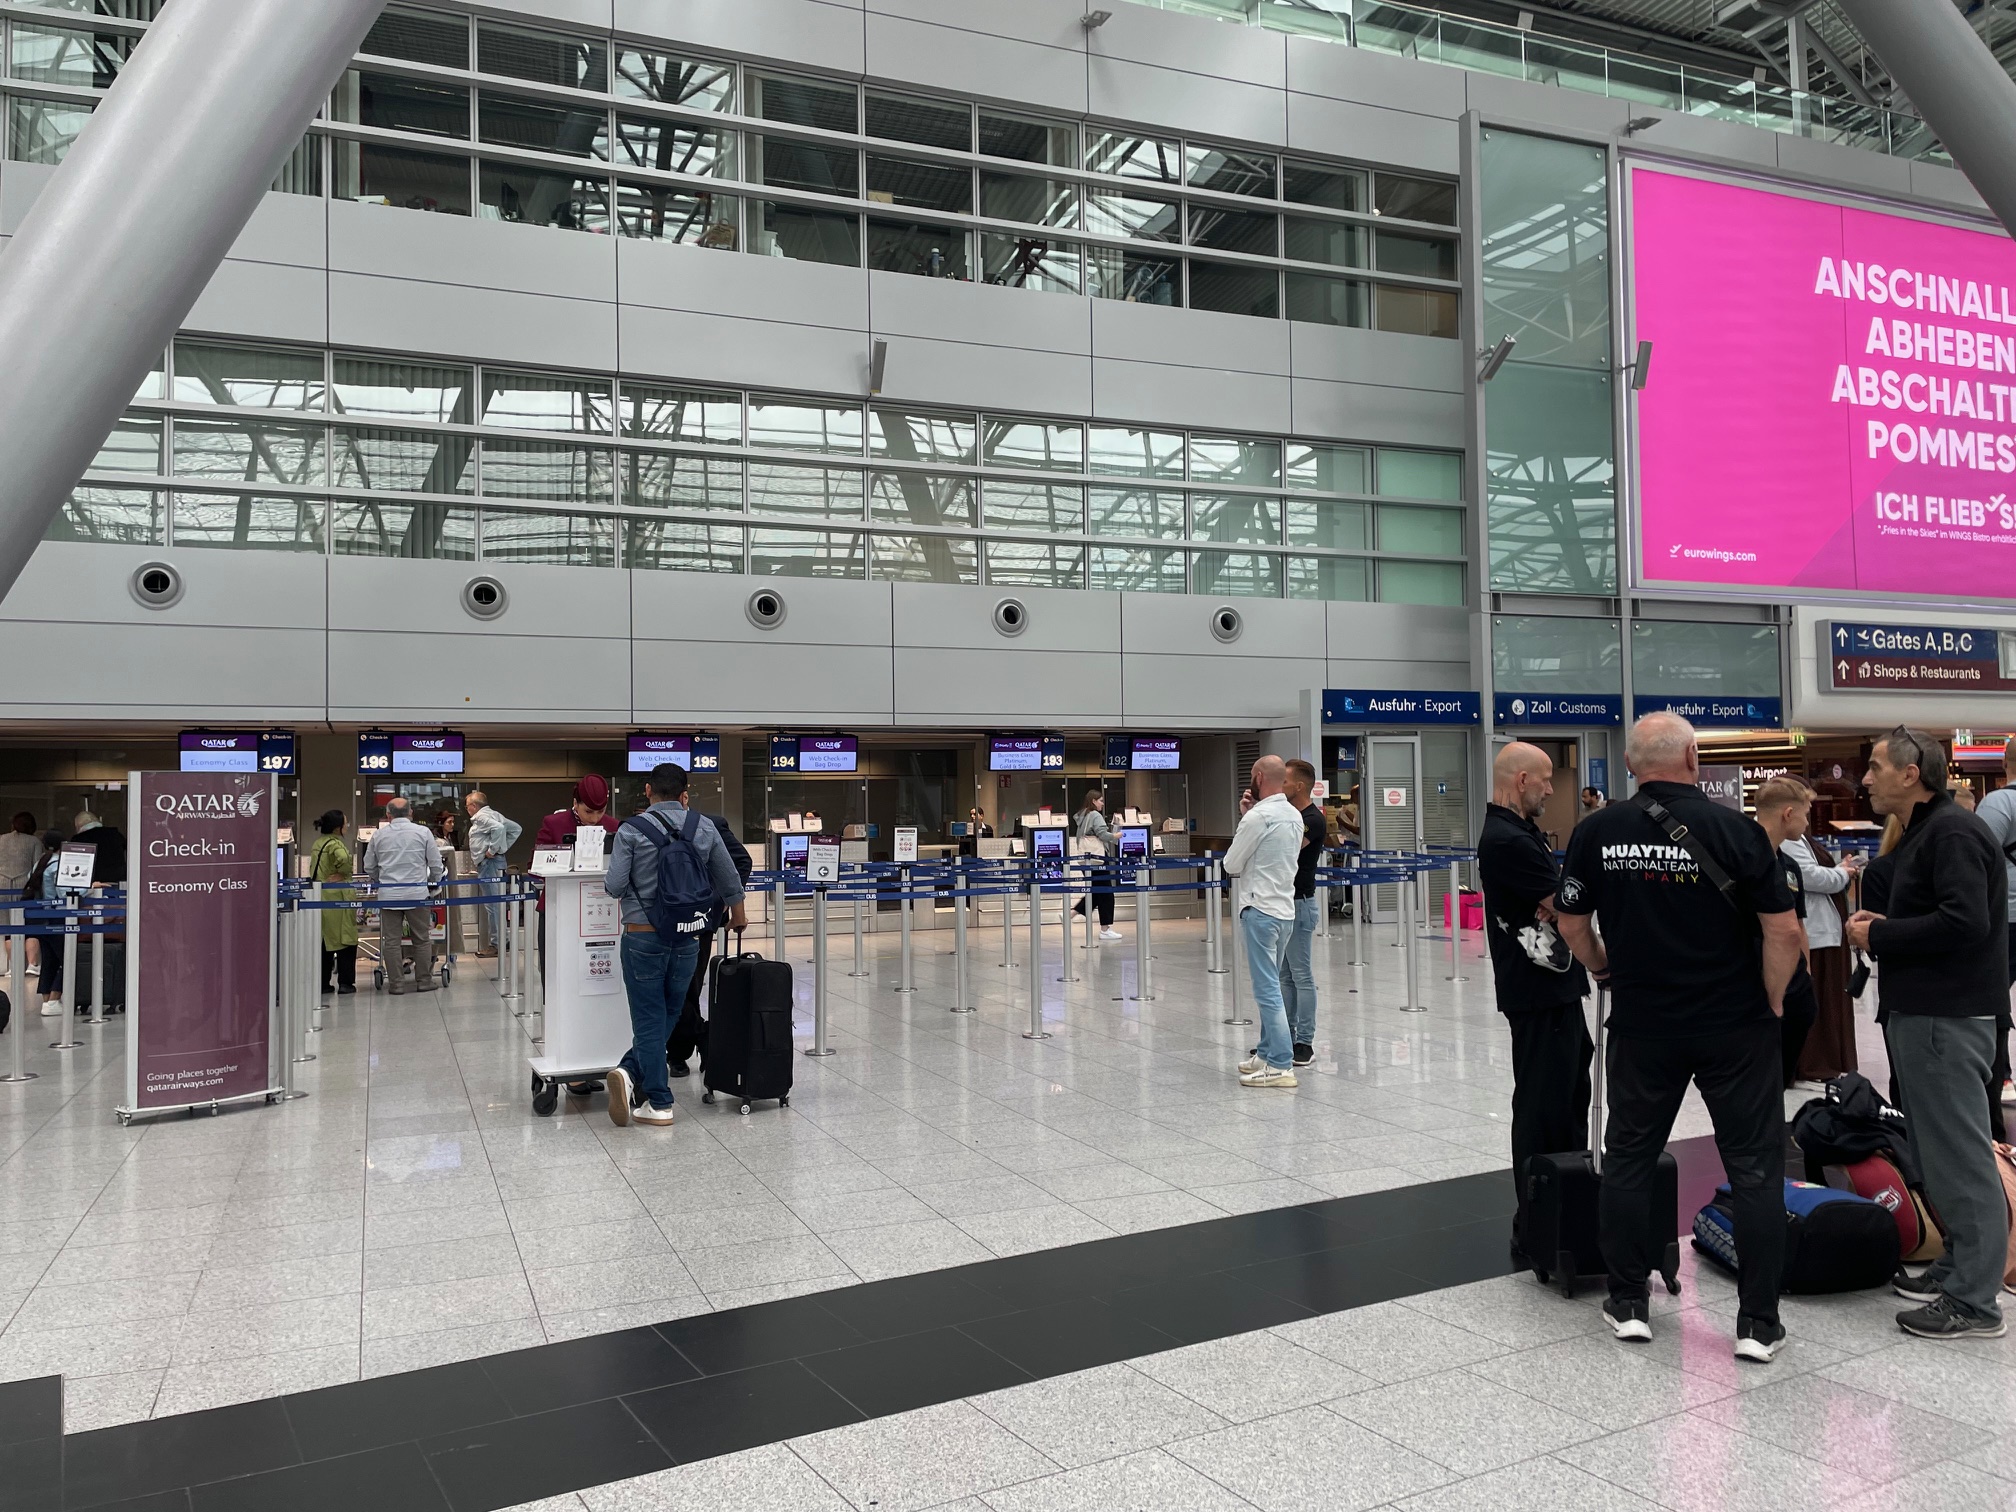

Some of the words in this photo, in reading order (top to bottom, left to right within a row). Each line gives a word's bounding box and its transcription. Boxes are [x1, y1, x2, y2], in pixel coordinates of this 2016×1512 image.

[1876, 492, 1919, 522] ICH
[1900, 527, 1906, 535] in
[1907, 527, 1918, 536] the
[1949, 530, 1972, 541] WINGS
[1972, 532, 1990, 542] Bistro
[1684, 548, 1757, 562] eurowings.com
[1872, 629, 1921, 650] Gates
[1874, 664, 1908, 681] Shops
[1910, 665, 1918, 678] &
[1920, 666, 1981, 680] Restaurants
[1368, 698, 1417, 712] Ausfuhr
[1424, 698, 1462, 715] Export
[1531, 701, 1552, 714] Zoll
[1559, 702, 1606, 714] Customs
[1665, 703, 1706, 716] Ausfuhr
[1712, 704, 1744, 718] Export
[201, 738, 226, 747] QATAR
[262, 756, 292, 770] 197
[360, 756, 388, 768] 196
[694, 756, 718, 768] 195
[772, 756, 794, 767] 194
[1043, 755, 1062, 766] 193
[1108, 756, 1127, 766] 192
[156, 794, 235, 815] QATAR
[150, 838, 235, 857] Check-in
[1602, 844, 1692, 860] MUAYTHA
[1602, 860, 1699, 872] NATIONALTEAM
[148, 881, 214, 894] Economy
[218, 878, 248, 890] Class
[677, 918, 705, 932] PUMA
[147, 1073, 174, 1081] Going
[177, 1070, 204, 1080] places
[206, 1065, 238, 1076] together
[146, 1077, 224, 1093] qatarairways.com
